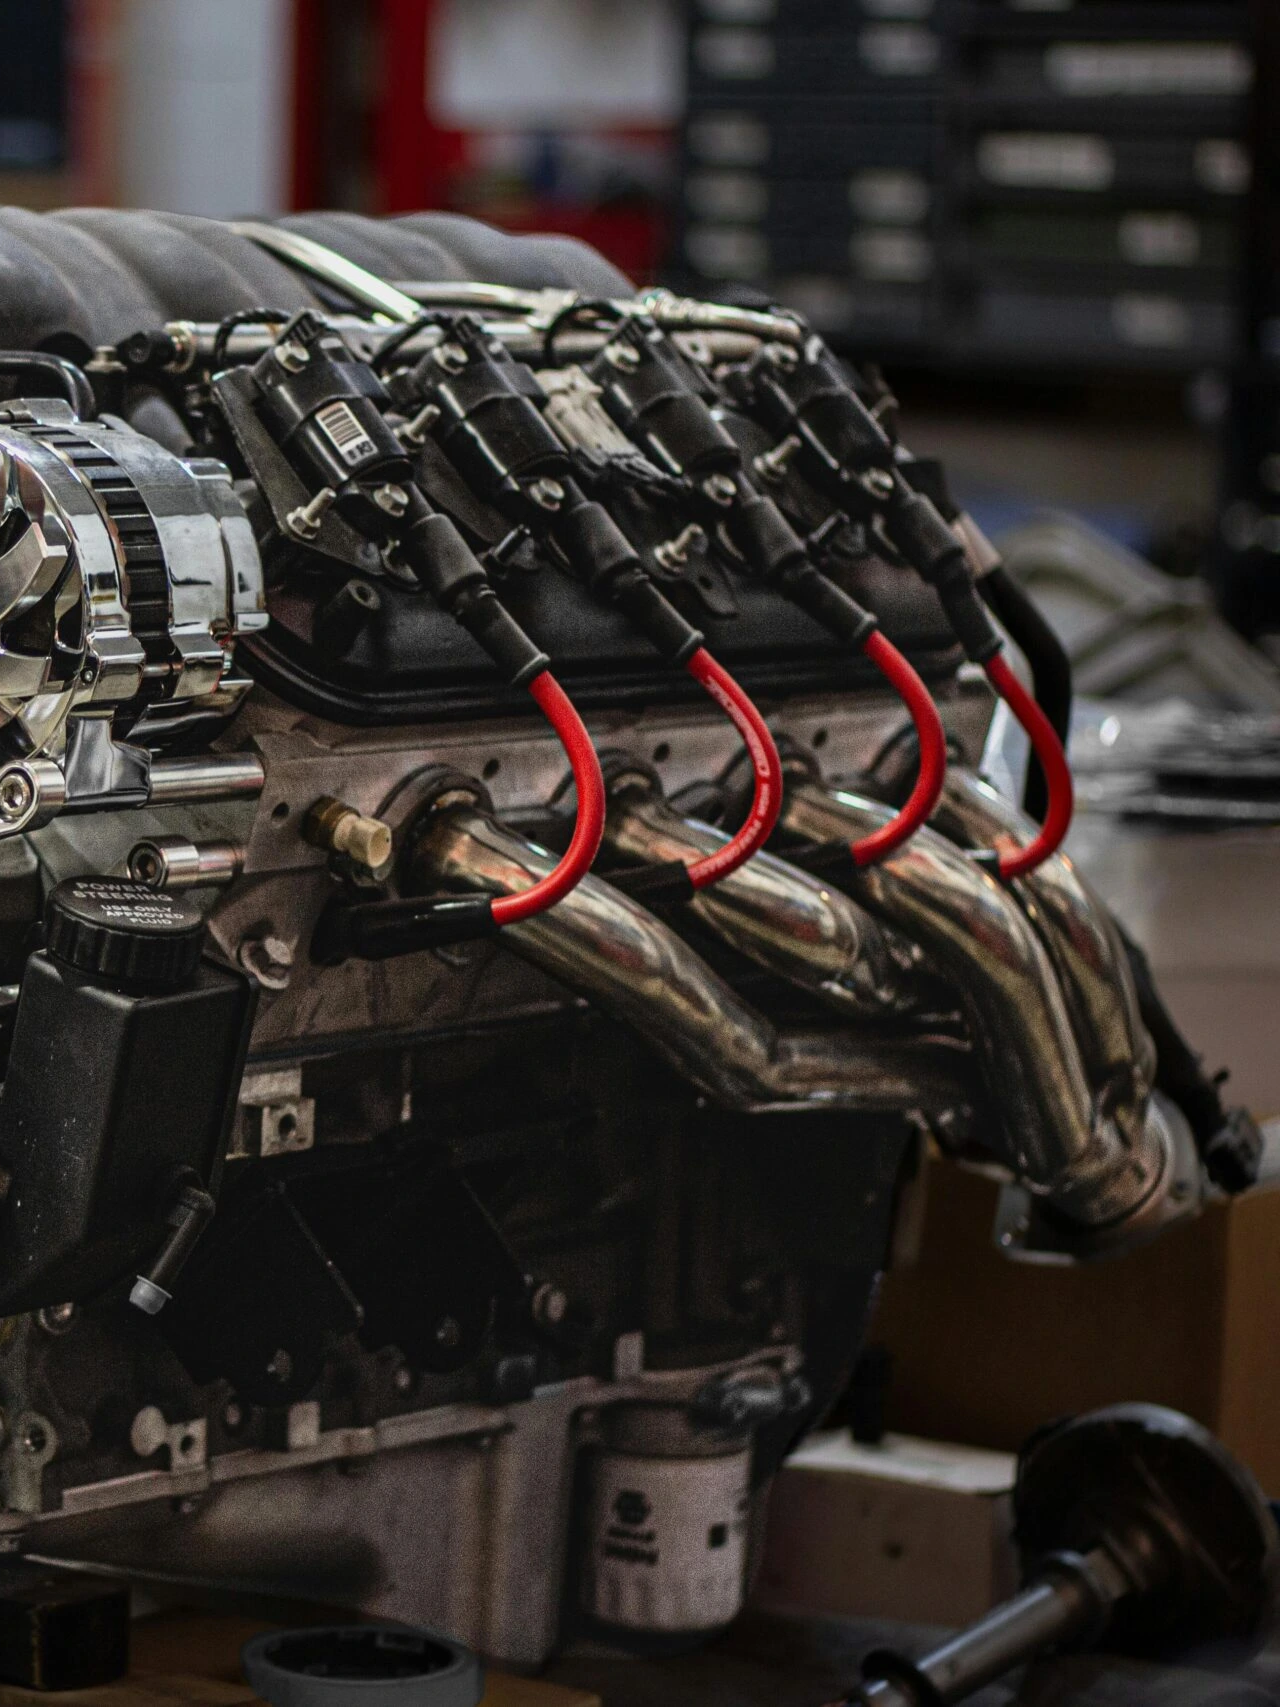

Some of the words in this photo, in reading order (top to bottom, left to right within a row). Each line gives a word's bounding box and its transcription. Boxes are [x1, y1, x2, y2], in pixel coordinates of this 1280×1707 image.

[75, 882, 151, 893] POWER
[72, 890, 174, 902] STEERING
[101, 904, 130, 912] USE
[134, 905, 172, 913] ONLY
[106, 911, 185, 919] APPROVED
[130, 917, 173, 925] FLUID
